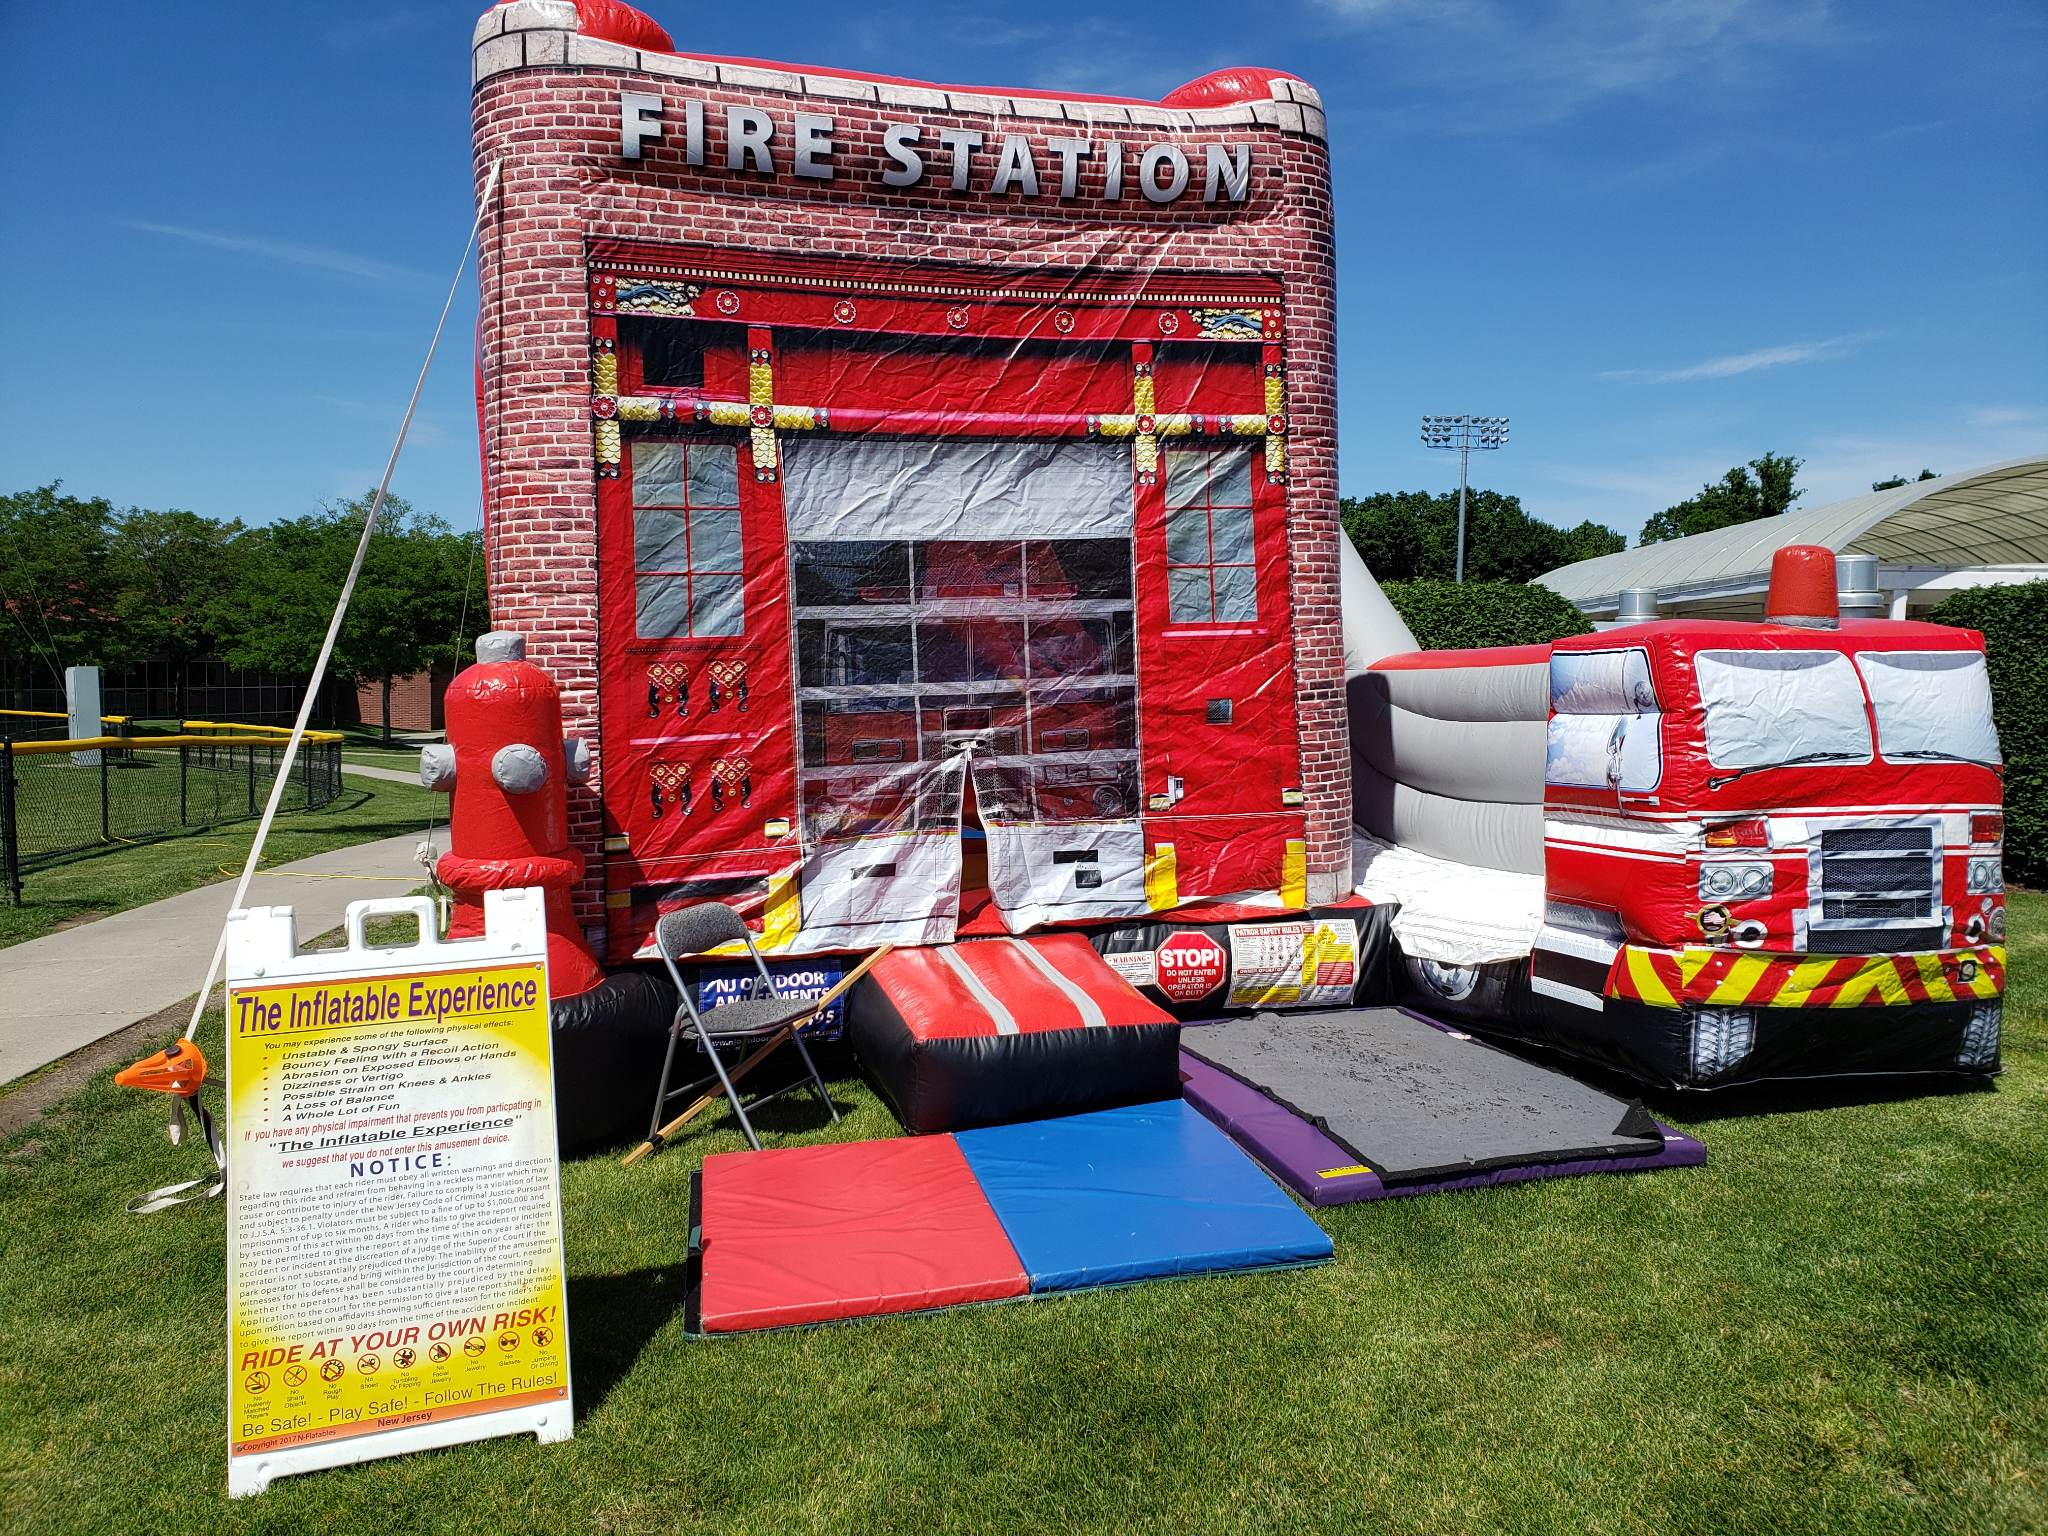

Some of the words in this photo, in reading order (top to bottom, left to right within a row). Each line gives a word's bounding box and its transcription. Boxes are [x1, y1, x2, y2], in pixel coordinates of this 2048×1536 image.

[620, 92, 834, 180] FIRE
[880, 123, 1252, 202] STATION
[1260, 927, 1280, 935] SAFETY
[1281, 926, 1300, 934] RULES
[1159, 948, 1220, 968] STOP!
[715, 979, 737, 992] NJ
[740, 972, 825, 991] ODOOR
[1166, 969, 1177, 977] DO
[237, 996, 281, 1033] The
[289, 985, 400, 1029] Inflatable
[408, 976, 537, 1024] Experience
[264, 1042, 282, 1050] You
[303, 1036, 352, 1046] experience
[353, 1033, 378, 1041] some
[406, 1026, 445, 1036] following
[446, 1022, 482, 1033] physical
[281, 1060, 330, 1070] Bouncy
[333, 1055, 378, 1065] Feeling
[382, 1051, 406, 1060] with
[421, 1045, 458, 1056] Recoil
[461, 1043, 499, 1052] Action
[282, 1048, 336, 1060] Unstable
[352, 1043, 400, 1054] Spongy
[402, 1038, 448, 1048] Surface
[282, 1069, 338, 1080] Abrasion
[361, 1060, 414, 1072] Exposed
[417, 1057, 460, 1066] Elbows
[480, 1050, 516, 1060] Hands
[282, 1079, 341, 1091] Dizziness
[361, 1072, 404, 1082] Vertigo
[282, 1089, 335, 1101] Possible
[339, 1085, 375, 1095] Strain
[398, 1079, 435, 1089] Knees
[451, 1073, 491, 1083] Ankles
[282, 1114, 292, 1122] A
[296, 1110, 334, 1120] Whole
[338, 1107, 358, 1116] Lot
[361, 1104, 375, 1113] of
[377, 1103, 400, 1111] Fun
[296, 1101, 326, 1110] Loss
[330, 1098, 343, 1106] of
[346, 1094, 394, 1104] Balance
[254, 1130, 271, 1142] you
[272, 1128, 293, 1138] have
[294, 1126, 310, 1137] any
[311, 1120, 346, 1136] physical
[348, 1115, 395, 1129] impairment
[396, 1113, 412, 1124] that
[413, 1110, 448, 1122] prevents
[450, 1109, 464, 1120] you
[466, 1106, 484, 1116] from
[533, 1098, 542, 1108] in
[319, 1129, 406, 1149] Inflatable
[282, 1160, 294, 1168] we
[296, 1155, 330, 1168] suggest
[331, 1152, 348, 1162] that
[349, 1151, 365, 1163] you
[366, 1148, 377, 1158] do
[379, 1147, 393, 1157] not
[394, 1145, 415, 1155] enter
[417, 1142, 432, 1152] this
[434, 1138, 480, 1150] amusement
[241, 1344, 304, 1371] RIDE
[309, 1338, 344, 1360] AT
[351, 1326, 420, 1353] YOUR
[428, 1316, 486, 1341] OWN
[492, 1305, 556, 1331] RISK!
[242, 1423, 264, 1437] Be
[271, 1412, 312, 1432] Safe!
[329, 1407, 363, 1422] Play
[368, 1396, 408, 1415] Safe!
[425, 1388, 472, 1406] Follow
[477, 1382, 506, 1396] The
[512, 1372, 557, 1390] Rules!
[377, 1418, 399, 1427] New
[401, 1412, 432, 1424] Jersey
[280, 1435, 297, 1445] 2017
